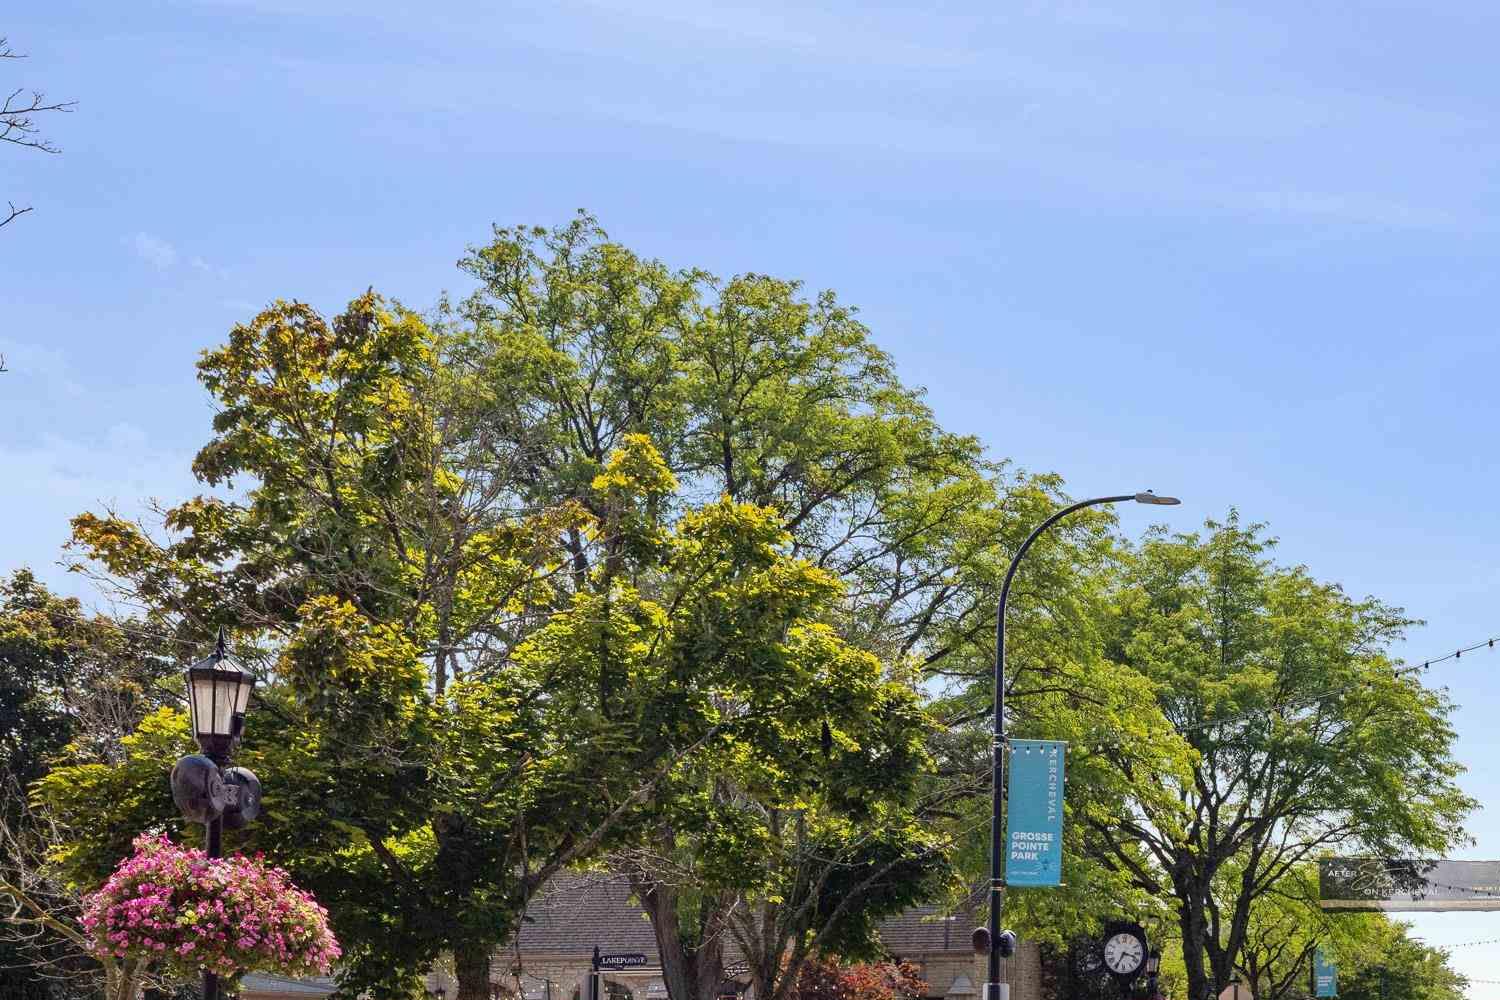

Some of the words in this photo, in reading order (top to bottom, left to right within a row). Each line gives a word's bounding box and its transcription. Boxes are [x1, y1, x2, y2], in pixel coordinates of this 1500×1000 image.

[1048, 749, 1057, 823] KERCHEVAL
[1011, 832, 1054, 842] GROSSE
[1011, 842, 1049, 851] POINTE
[1011, 851, 1039, 861] PARK
[1328, 870, 1357, 878] AFTER
[1364, 888, 1379, 896] ON
